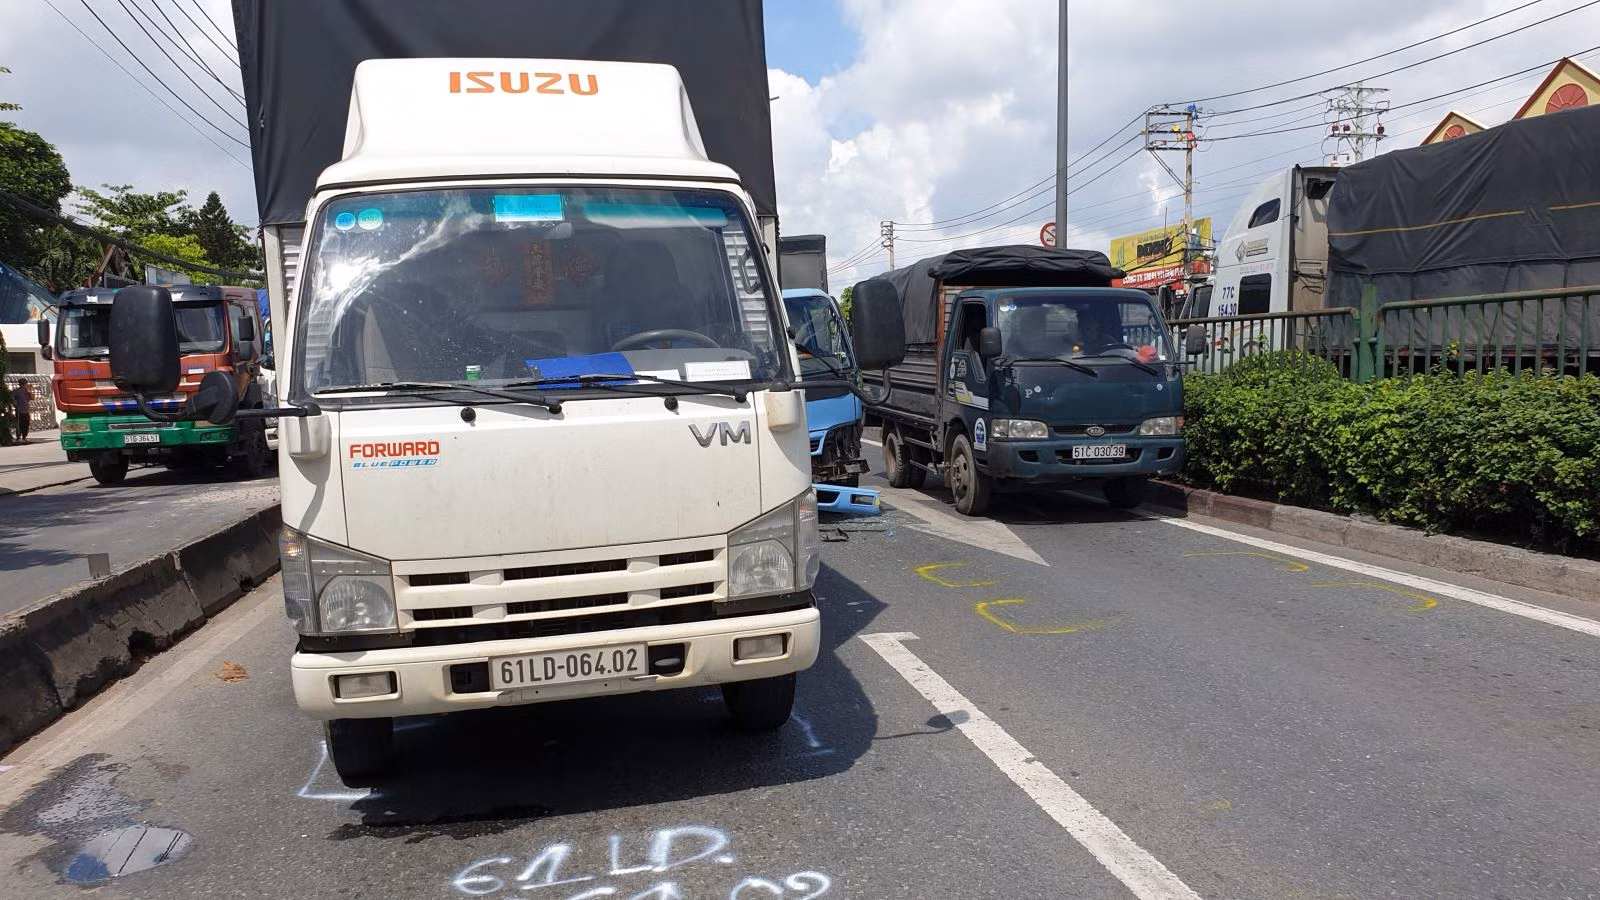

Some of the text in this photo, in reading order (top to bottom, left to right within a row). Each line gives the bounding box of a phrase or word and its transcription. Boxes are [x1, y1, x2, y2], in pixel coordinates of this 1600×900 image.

[449, 71, 599, 96] ISUZU
[1222, 286, 1235, 299] 77C
[688, 420, 752, 448] VM
[349, 440, 441, 459] FORWARD
[352, 458, 438, 468] BLUEPOWER
[501, 647, 638, 684] 61LD-064.02
